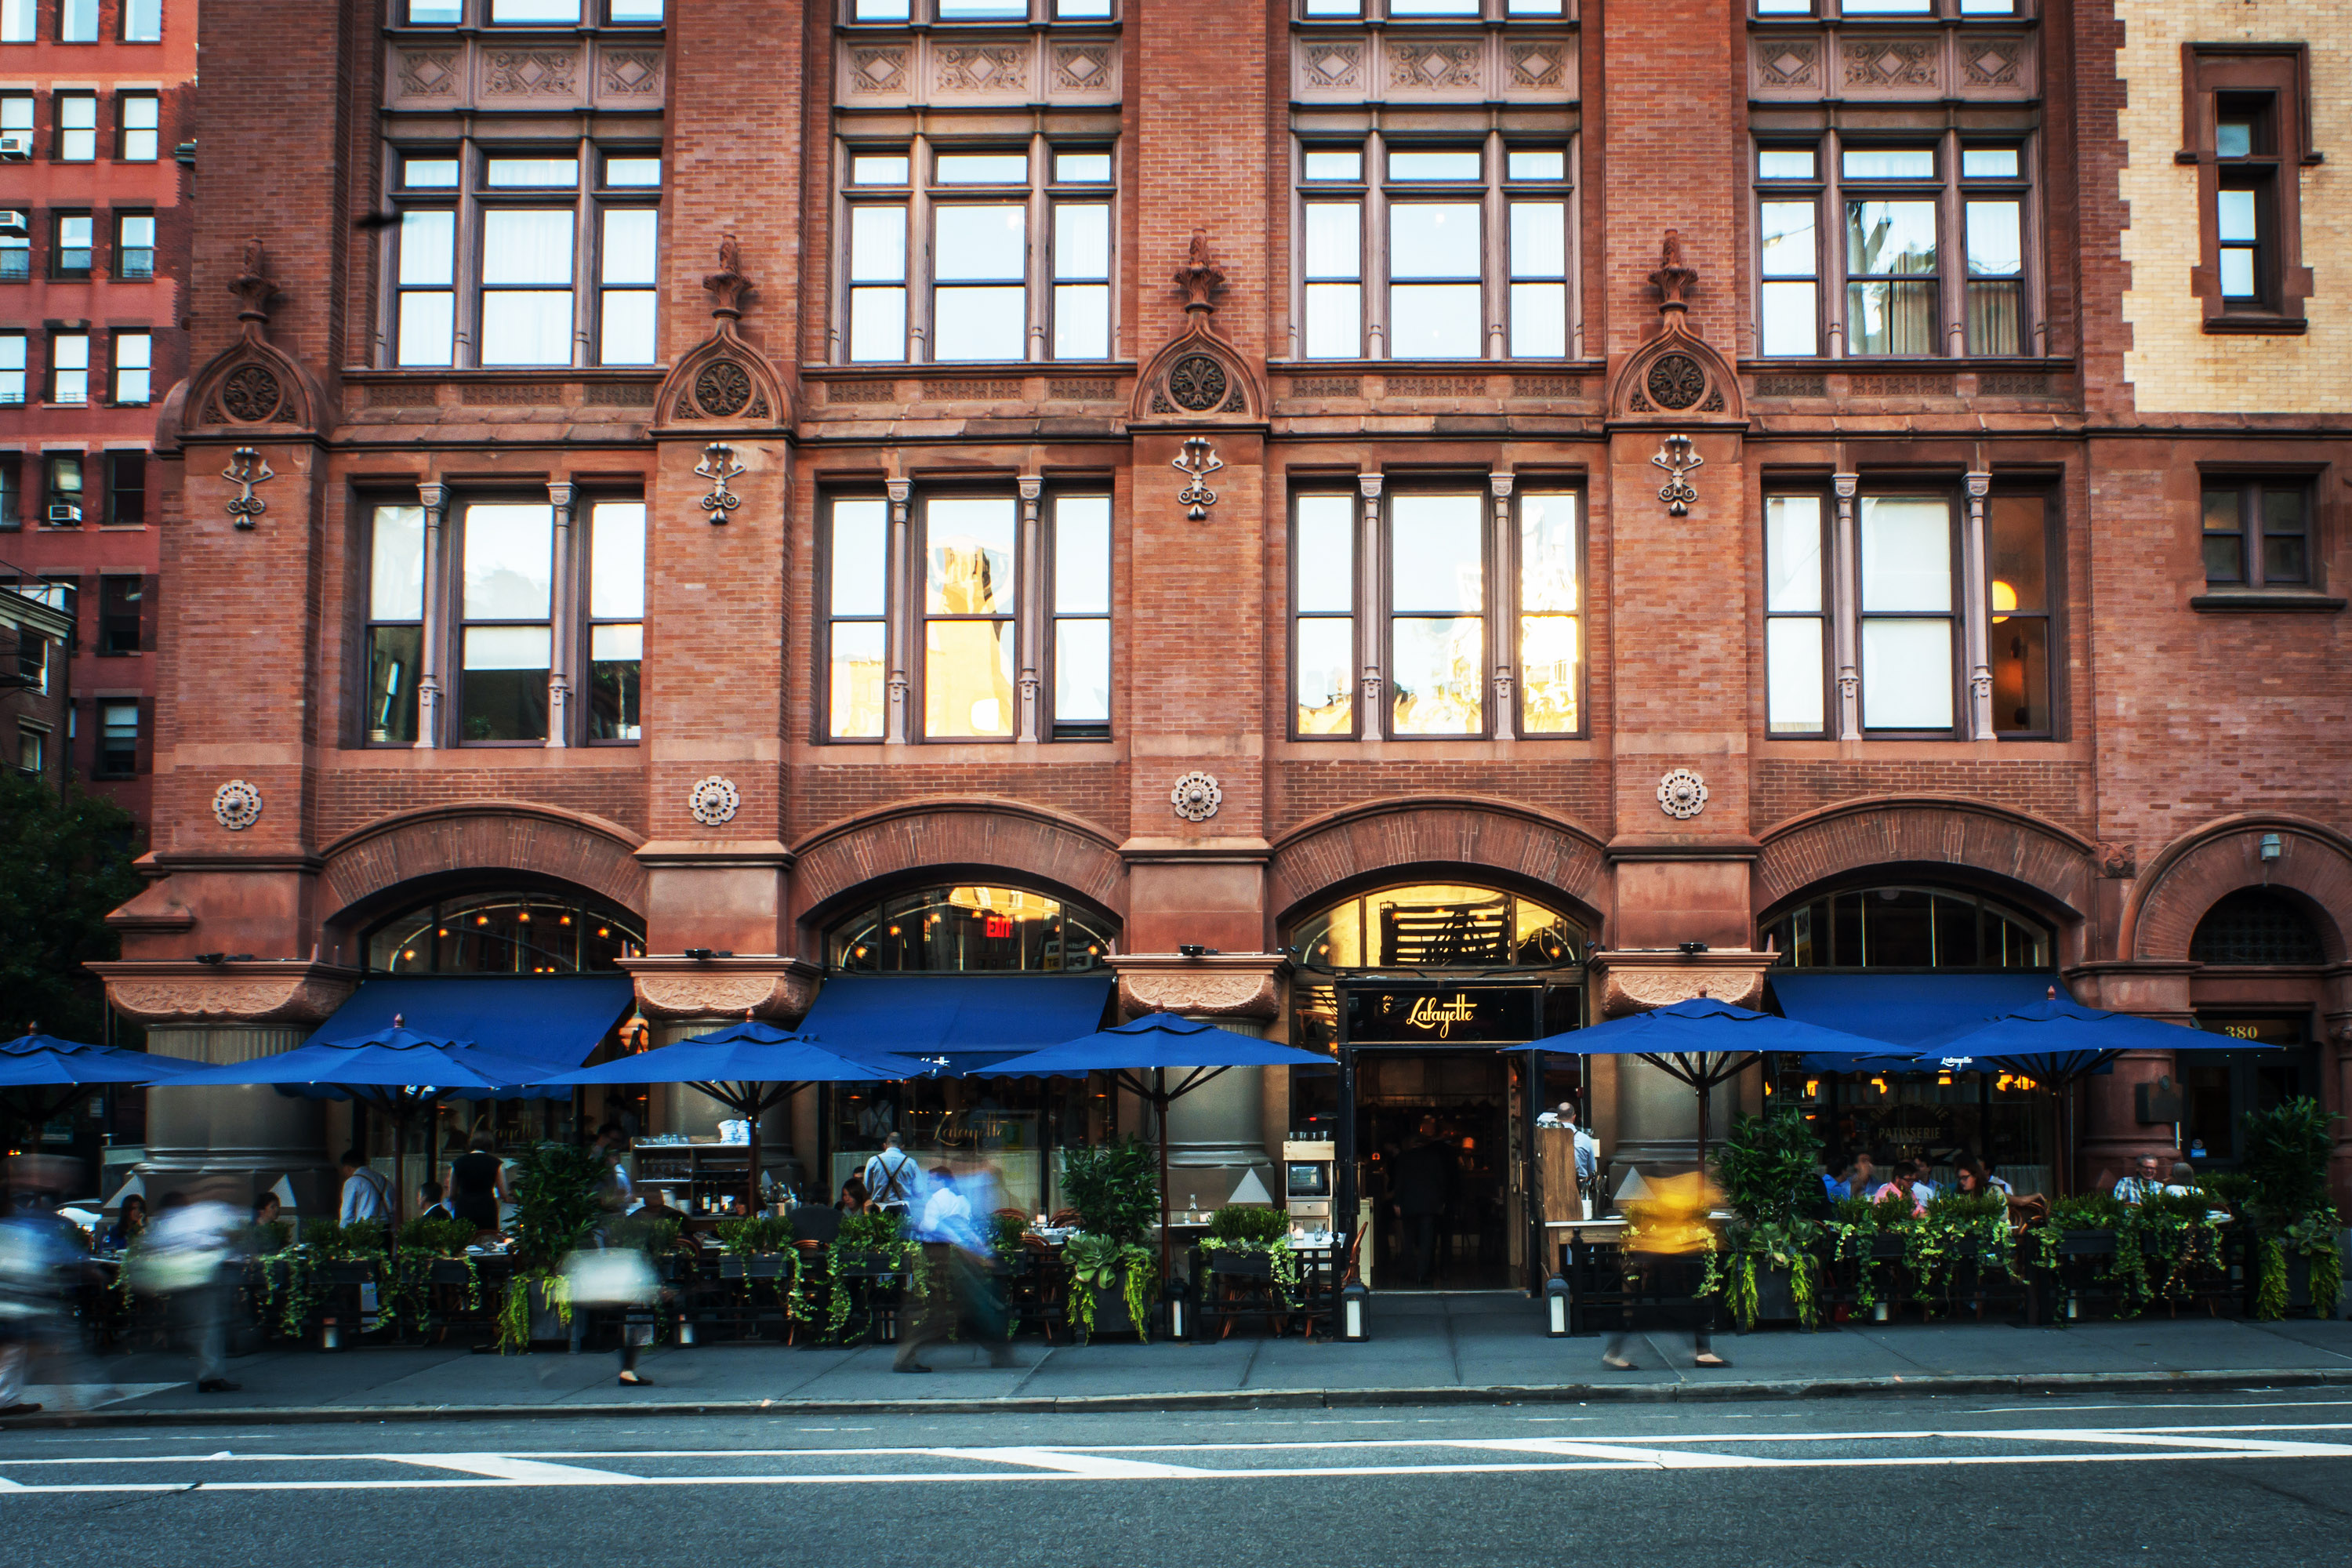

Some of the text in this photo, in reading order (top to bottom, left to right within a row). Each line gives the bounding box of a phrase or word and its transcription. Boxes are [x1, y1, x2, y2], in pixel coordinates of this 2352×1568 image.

[1406, 993, 1478, 1038] Lafayette
[2225, 1025, 2258, 1039] 380
[1940, 1056, 1973, 1071] Lafayette
[1878, 1127, 1941, 1139] PATISSERIE
